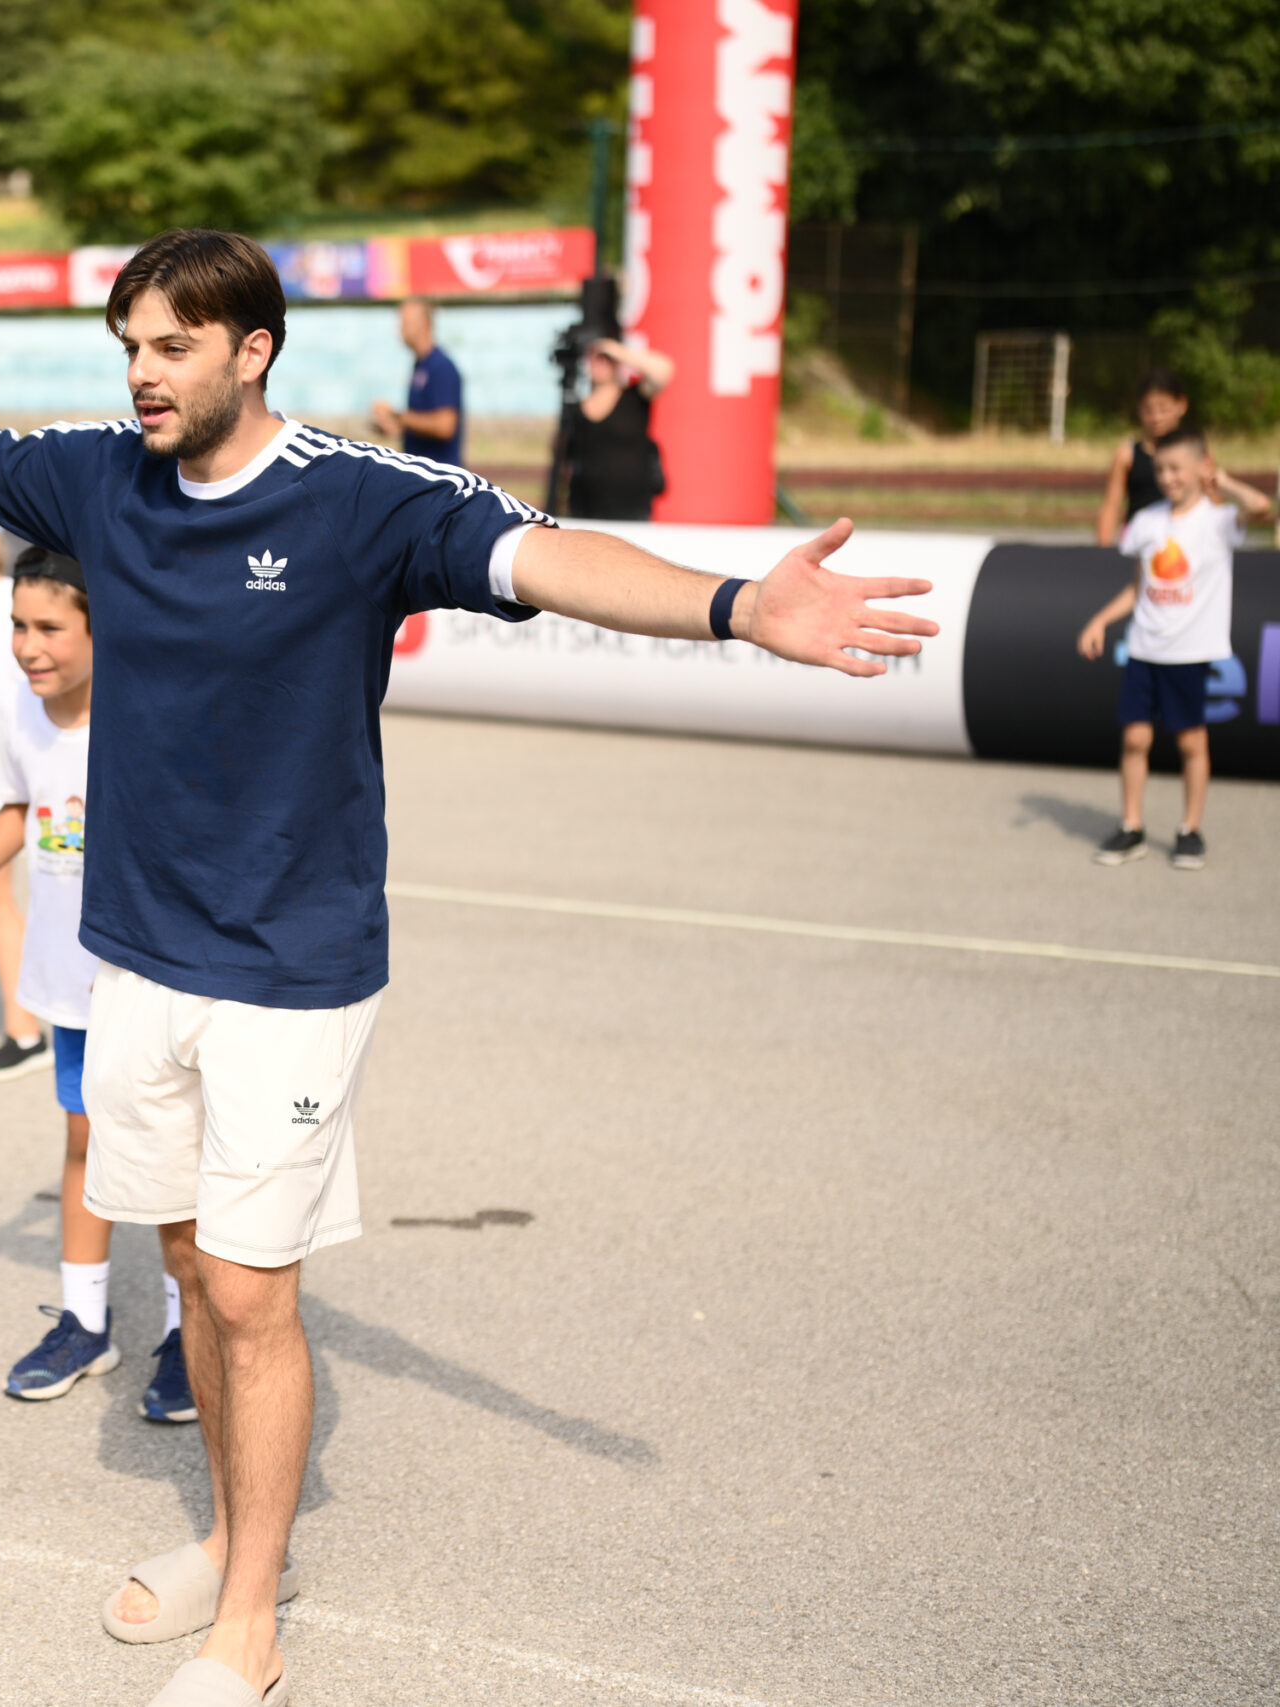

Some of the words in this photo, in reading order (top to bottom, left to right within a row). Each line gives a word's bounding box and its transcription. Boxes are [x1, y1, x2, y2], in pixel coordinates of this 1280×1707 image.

[709, 0, 793, 397] TOMMY
[245, 578, 287, 591] adidas
[448, 613, 634, 657] SPORTSKE
[291, 1116, 320, 1125] adidas
